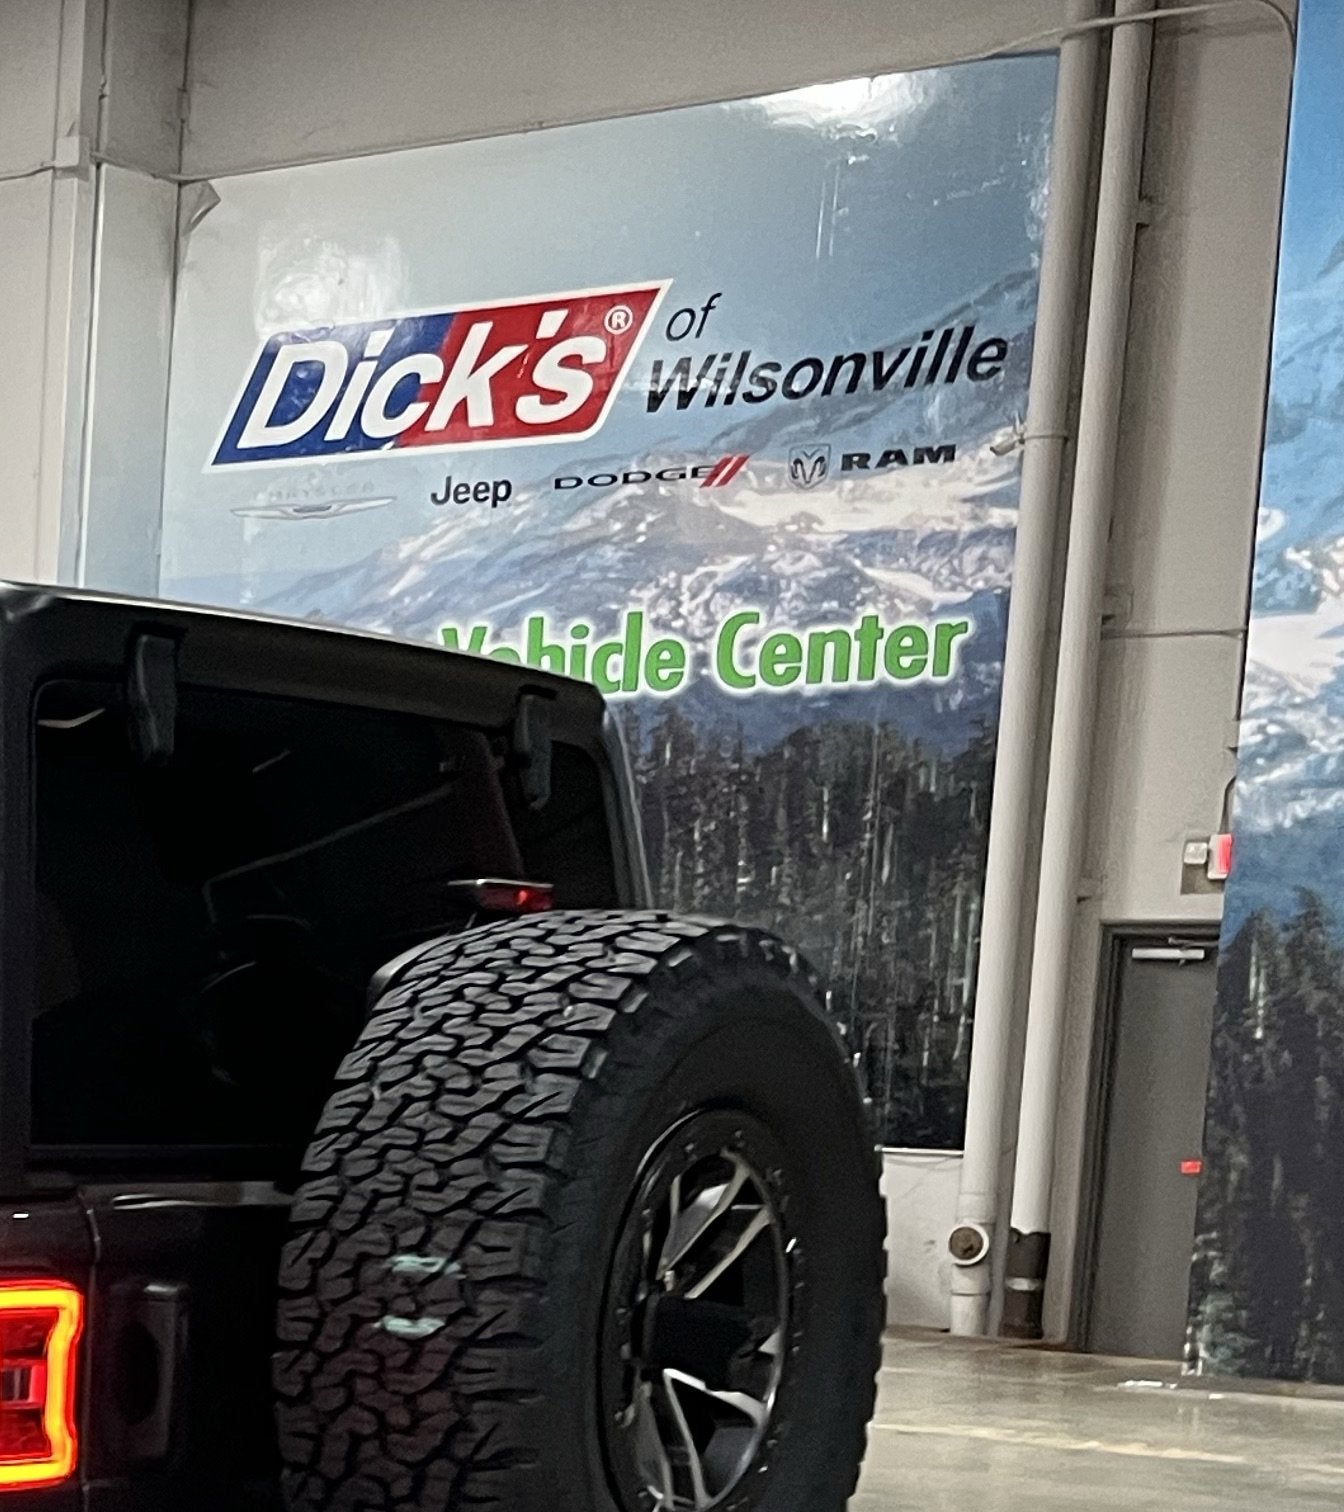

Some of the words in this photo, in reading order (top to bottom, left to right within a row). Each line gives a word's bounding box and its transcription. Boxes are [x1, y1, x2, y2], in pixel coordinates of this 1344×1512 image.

[665, 293, 722, 341] of
[237, 308, 606, 449] Dick's
[646, 325, 1008, 412] Wilsonville
[554, 465, 719, 490] DODGE
[840, 444, 957, 471] RAM
[430, 476, 513, 507] Jeep
[717, 611, 969, 689] Center
